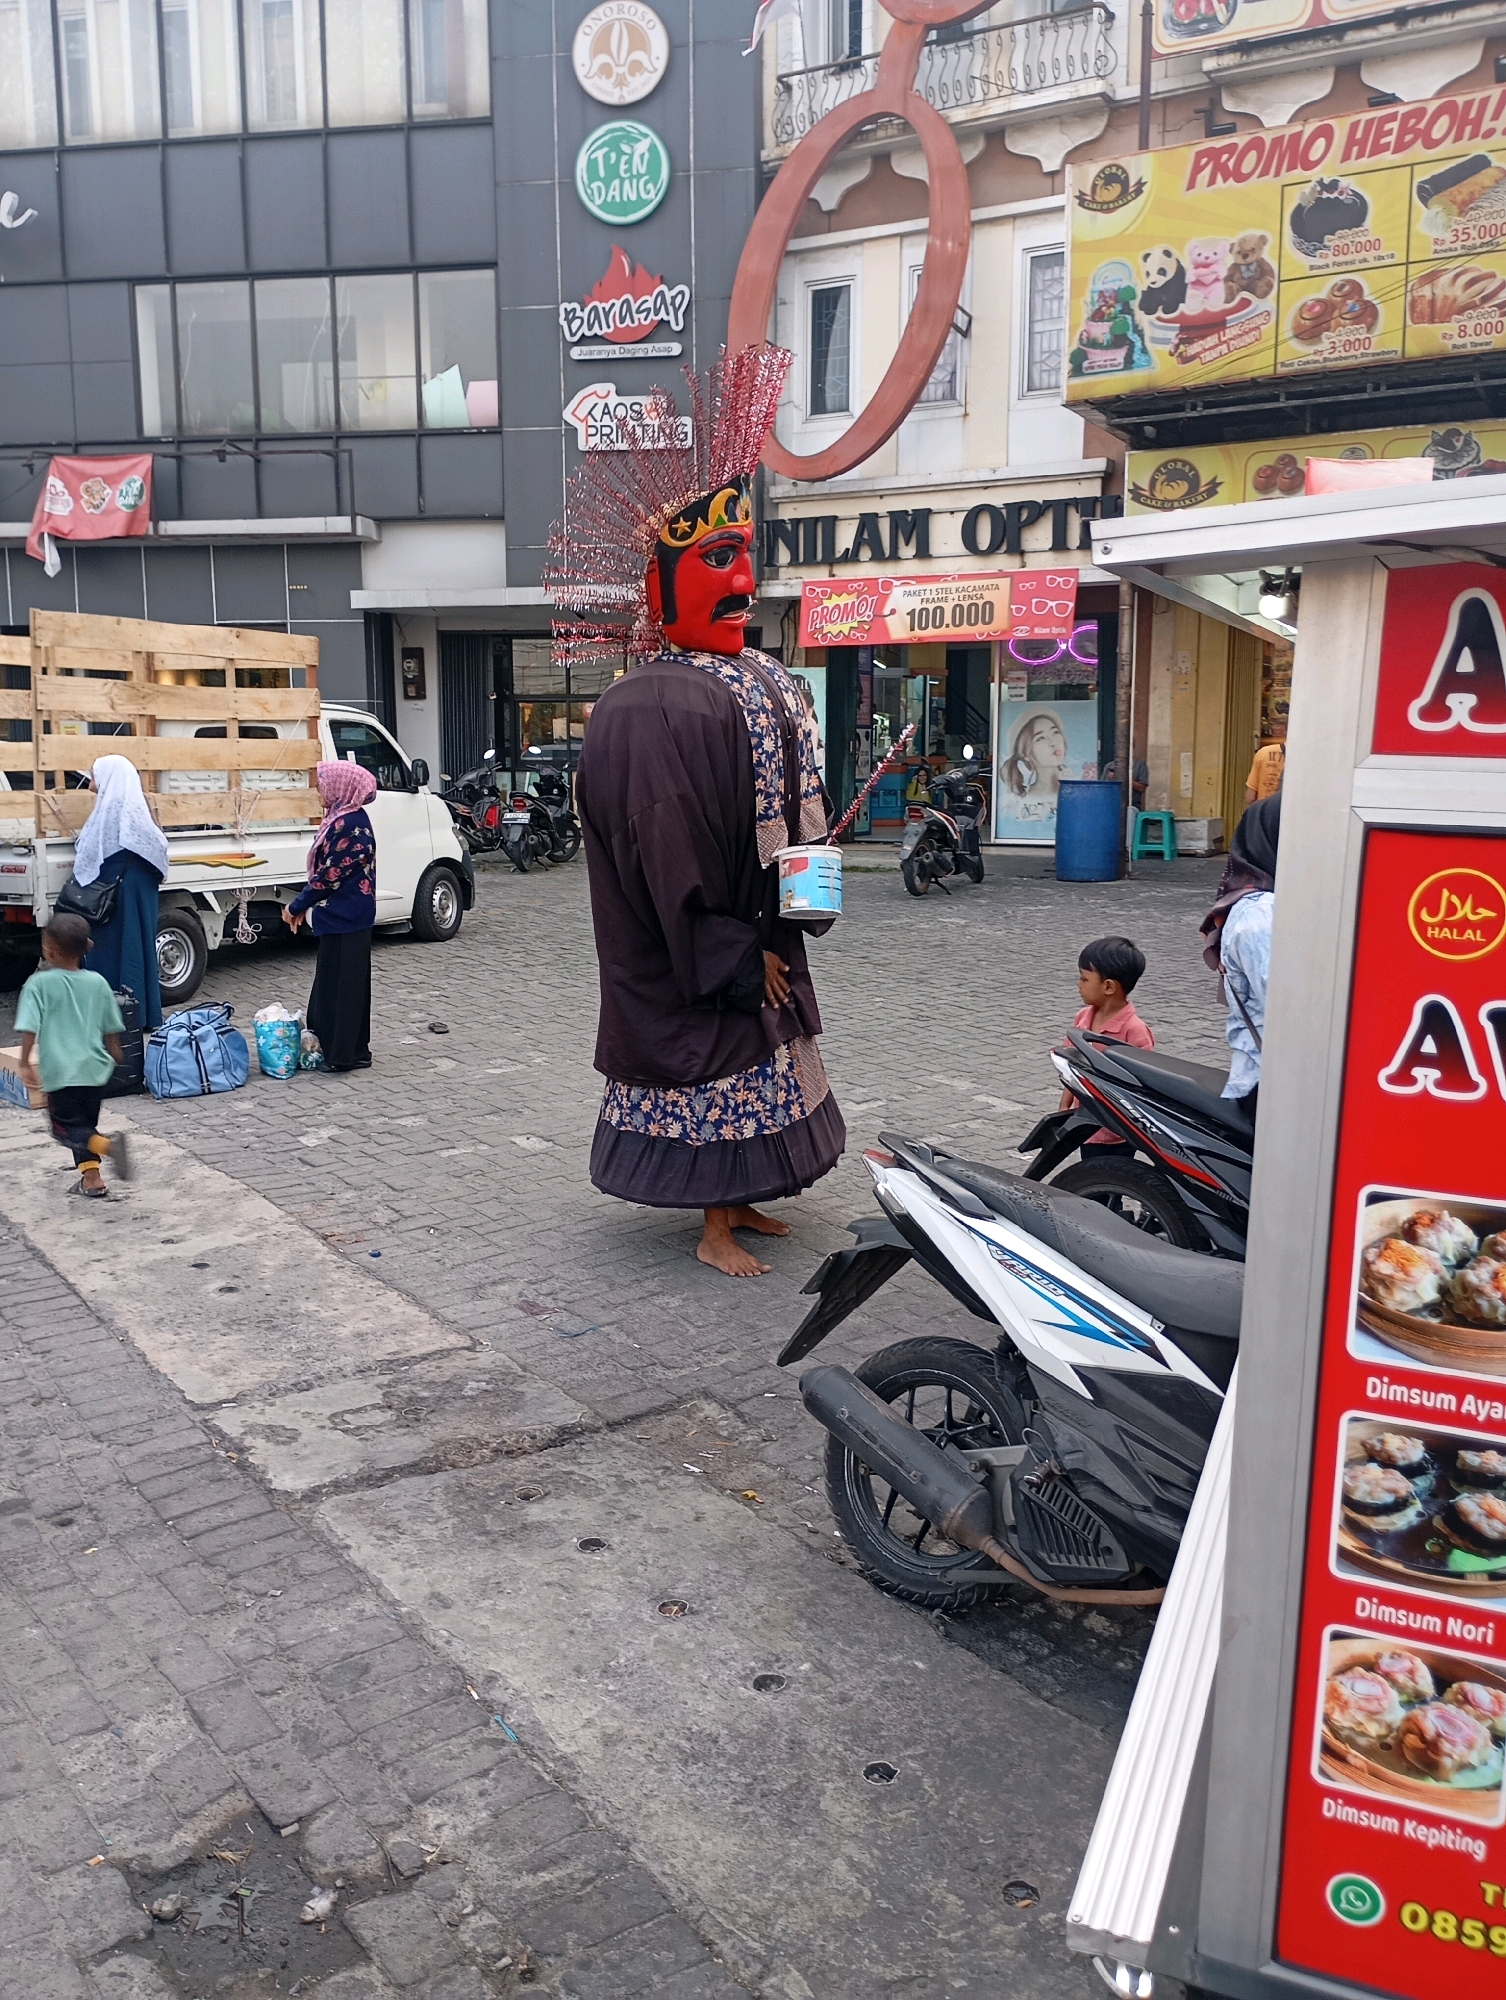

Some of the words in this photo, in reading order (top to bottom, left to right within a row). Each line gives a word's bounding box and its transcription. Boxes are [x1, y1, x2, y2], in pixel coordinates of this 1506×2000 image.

[582, 3, 656, 36] ONOROSO
[1186, 123, 1334, 192] PROMO
[590, 176, 655, 205] DANG
[1332, 238, 1381, 257] 80.000
[1309, 262, 1331, 271] Black
[1332, 259, 1357, 268] Forest
[563, 288, 687, 339] Barasap
[1457, 320, 1505, 339] 8.000
[578, 348, 617, 357] Juaranya
[619, 346, 650, 356] Daging
[651, 345, 673, 354] Asap
[1328, 336, 1372, 355] 3.000
[1154, 461, 1197, 480] GLOBAL
[1140, 496, 1163, 508] CAKE
[1173, 491, 1208, 508] BAKERY
[764, 508, 932, 567] NILAM
[902, 589, 928, 598] PAKET
[935, 587, 954, 596] STEL
[955, 583, 1000, 594] KACAMATA
[920, 596, 949, 605] FRAME
[957, 593, 985, 602] LENSA
[808, 594, 879, 633] PROMO!
[906, 600, 995, 632] 100.000
[1419, 887, 1499, 924] حلال
[1427, 926, 1487, 942] HALAL
[1366, 1376, 1457, 1412] Dimsum
[1461, 1394, 1506, 1423] Aya
[1355, 1597, 1442, 1634] Dimsum
[1446, 1616, 1495, 1646] Nori
[1322, 1797, 1400, 1836] Dimsum
[1403, 1818, 1488, 1863] Kepiting
